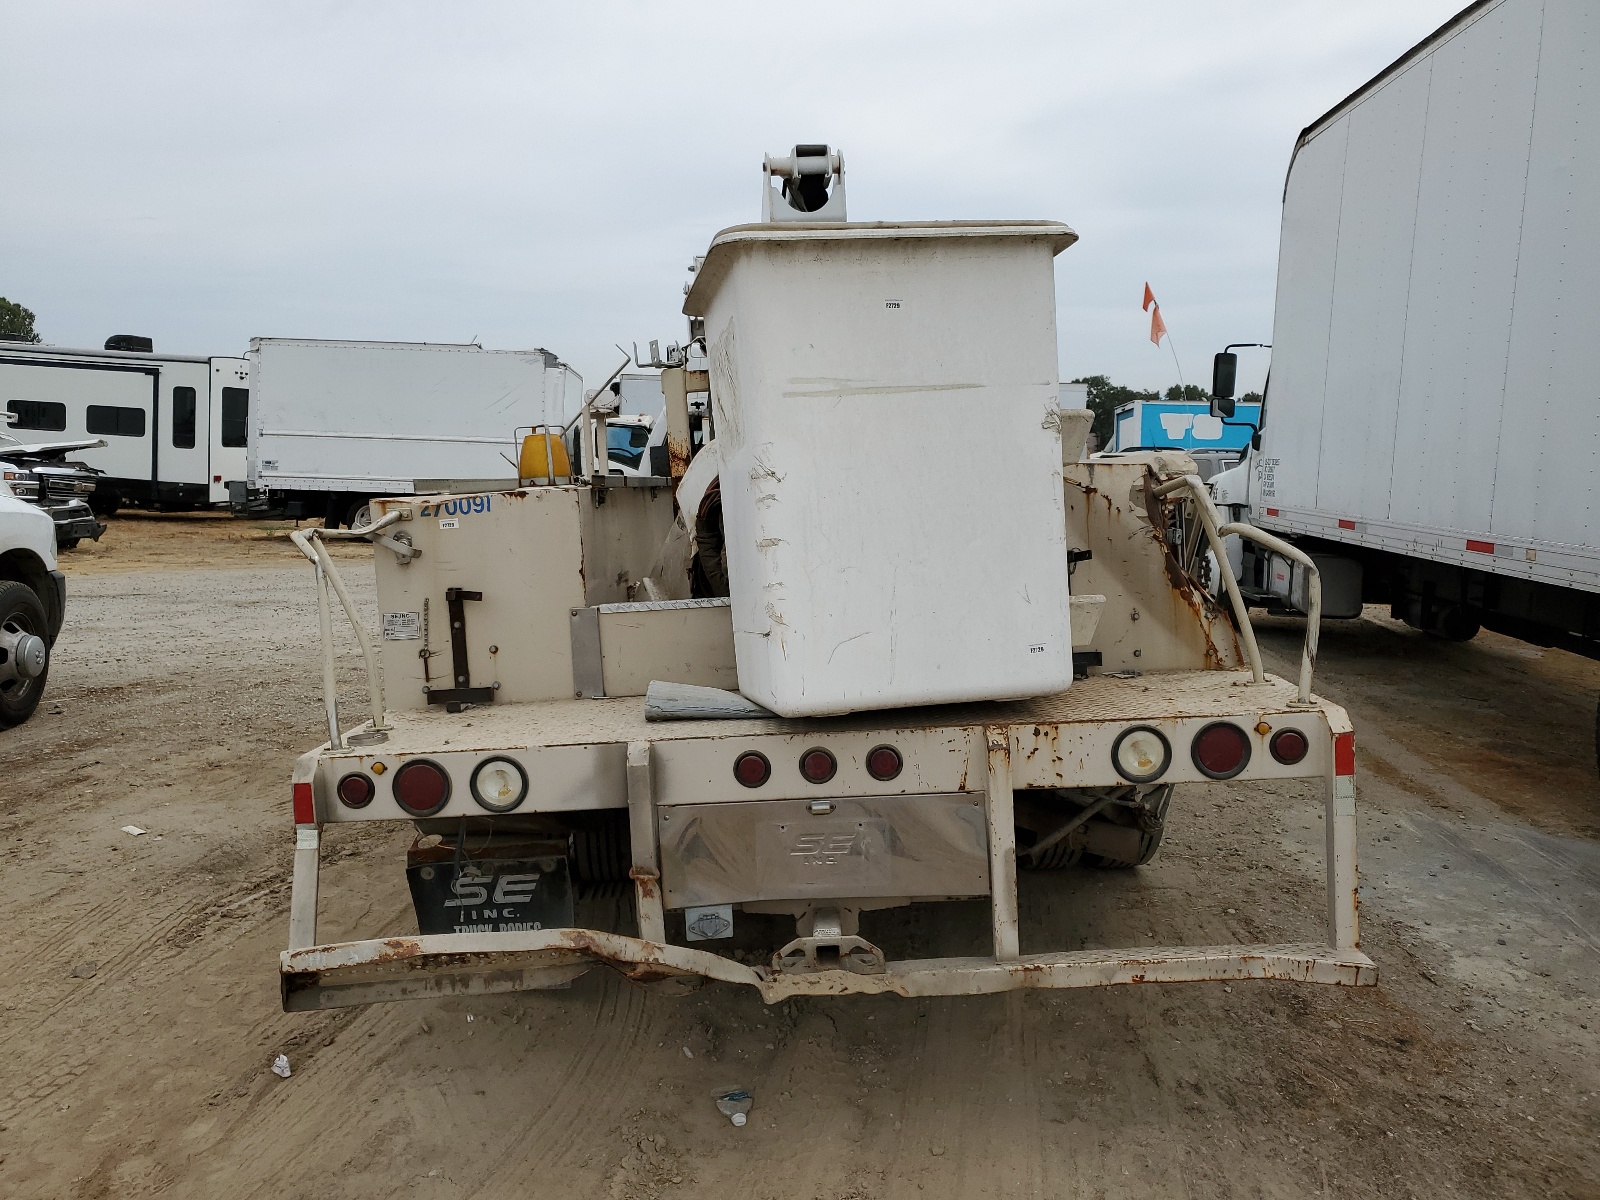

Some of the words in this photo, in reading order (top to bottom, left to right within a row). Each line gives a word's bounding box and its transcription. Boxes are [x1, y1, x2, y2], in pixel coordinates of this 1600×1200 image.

[420, 495, 491, 517] 270091
[789, 832, 857, 856] SE
[443, 873, 541, 908] SE
[471, 908, 520, 920] INC.
